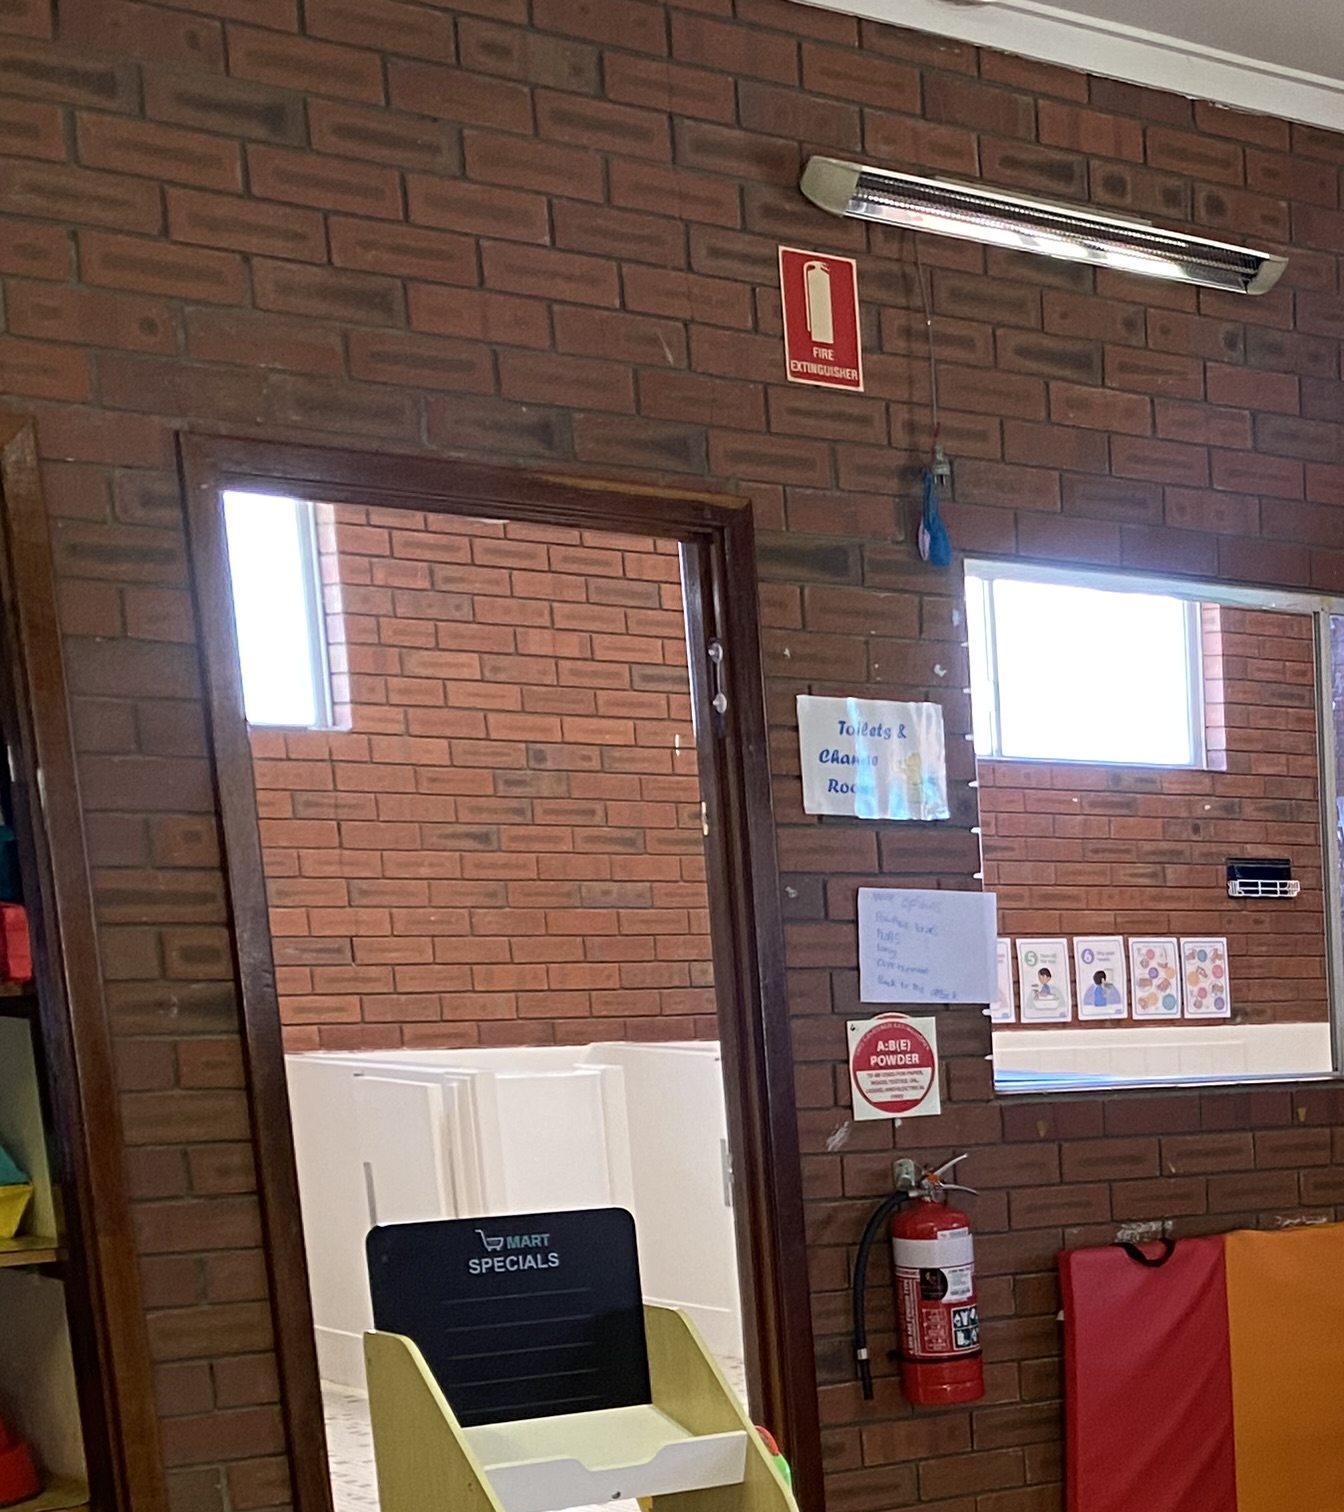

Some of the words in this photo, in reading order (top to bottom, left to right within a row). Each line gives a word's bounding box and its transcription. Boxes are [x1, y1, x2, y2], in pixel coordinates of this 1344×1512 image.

[813, 347, 834, 360] FIRE
[790, 360, 858, 380] EXTINGUISHER
[838, 720, 891, 740] Toilets
[896, 723, 907, 739] &
[1027, 952, 1035, 965] 5
[1084, 950, 1092, 964] 6
[876, 1039, 911, 1052] A:B(E)
[870, 1053, 919, 1066] POWDER
[506, 1233, 550, 1250] MART
[468, 1252, 559, 1275] SPECIALS
